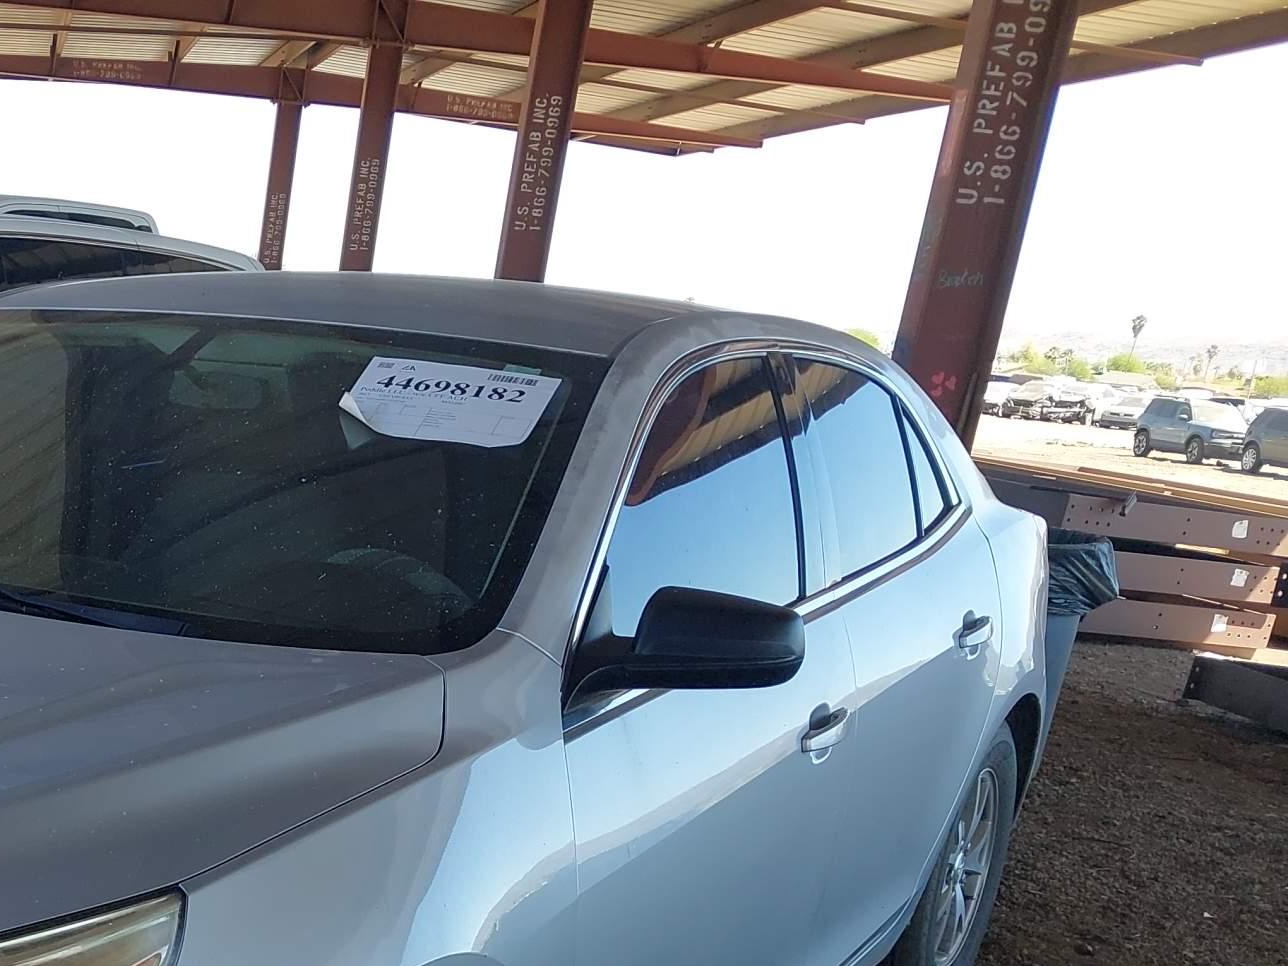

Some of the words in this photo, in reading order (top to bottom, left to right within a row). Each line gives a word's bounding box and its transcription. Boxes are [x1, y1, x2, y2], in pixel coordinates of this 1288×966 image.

[532, 93, 549, 123] INC.
[955, 152, 989, 205] U.S.
[973, 21, 1017, 134] PREFAB
[359, 157, 371, 178] INC.
[520, 131, 542, 192] PREFAB
[529, 95, 562, 231] 1-866-799-0969
[353, 183, 367, 225] PREFAB
[514, 202, 530, 231] U.S.
[349, 231, 361, 251] U.S.
[377, 375, 526, 403] 44698182
